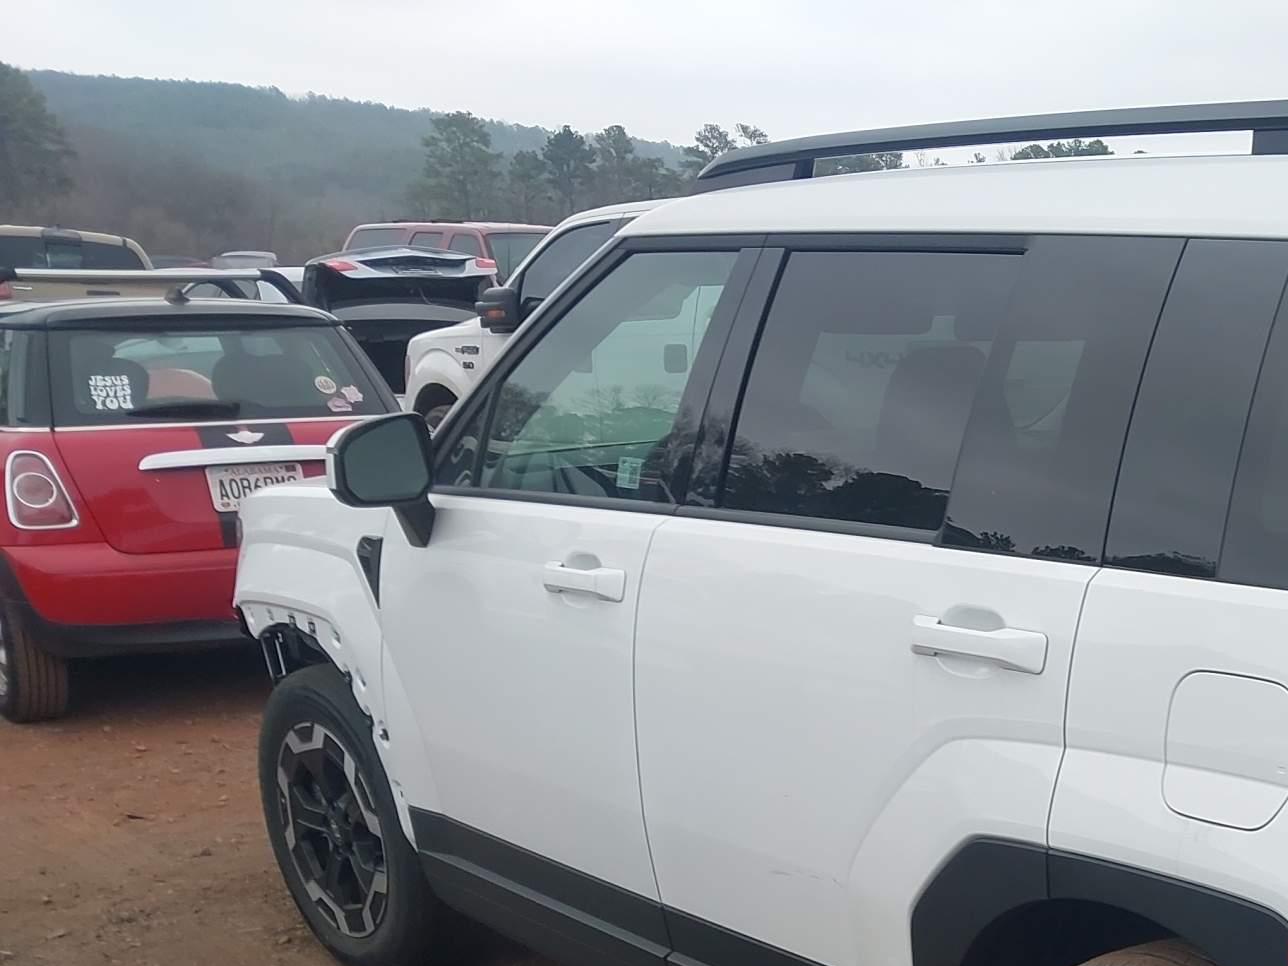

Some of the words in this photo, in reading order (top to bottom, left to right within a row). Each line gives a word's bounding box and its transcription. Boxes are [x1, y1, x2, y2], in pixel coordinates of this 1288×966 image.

[88, 375, 129, 385] JESUS
[89, 384, 131, 396] LOVES
[91, 395, 134, 409] YOU
